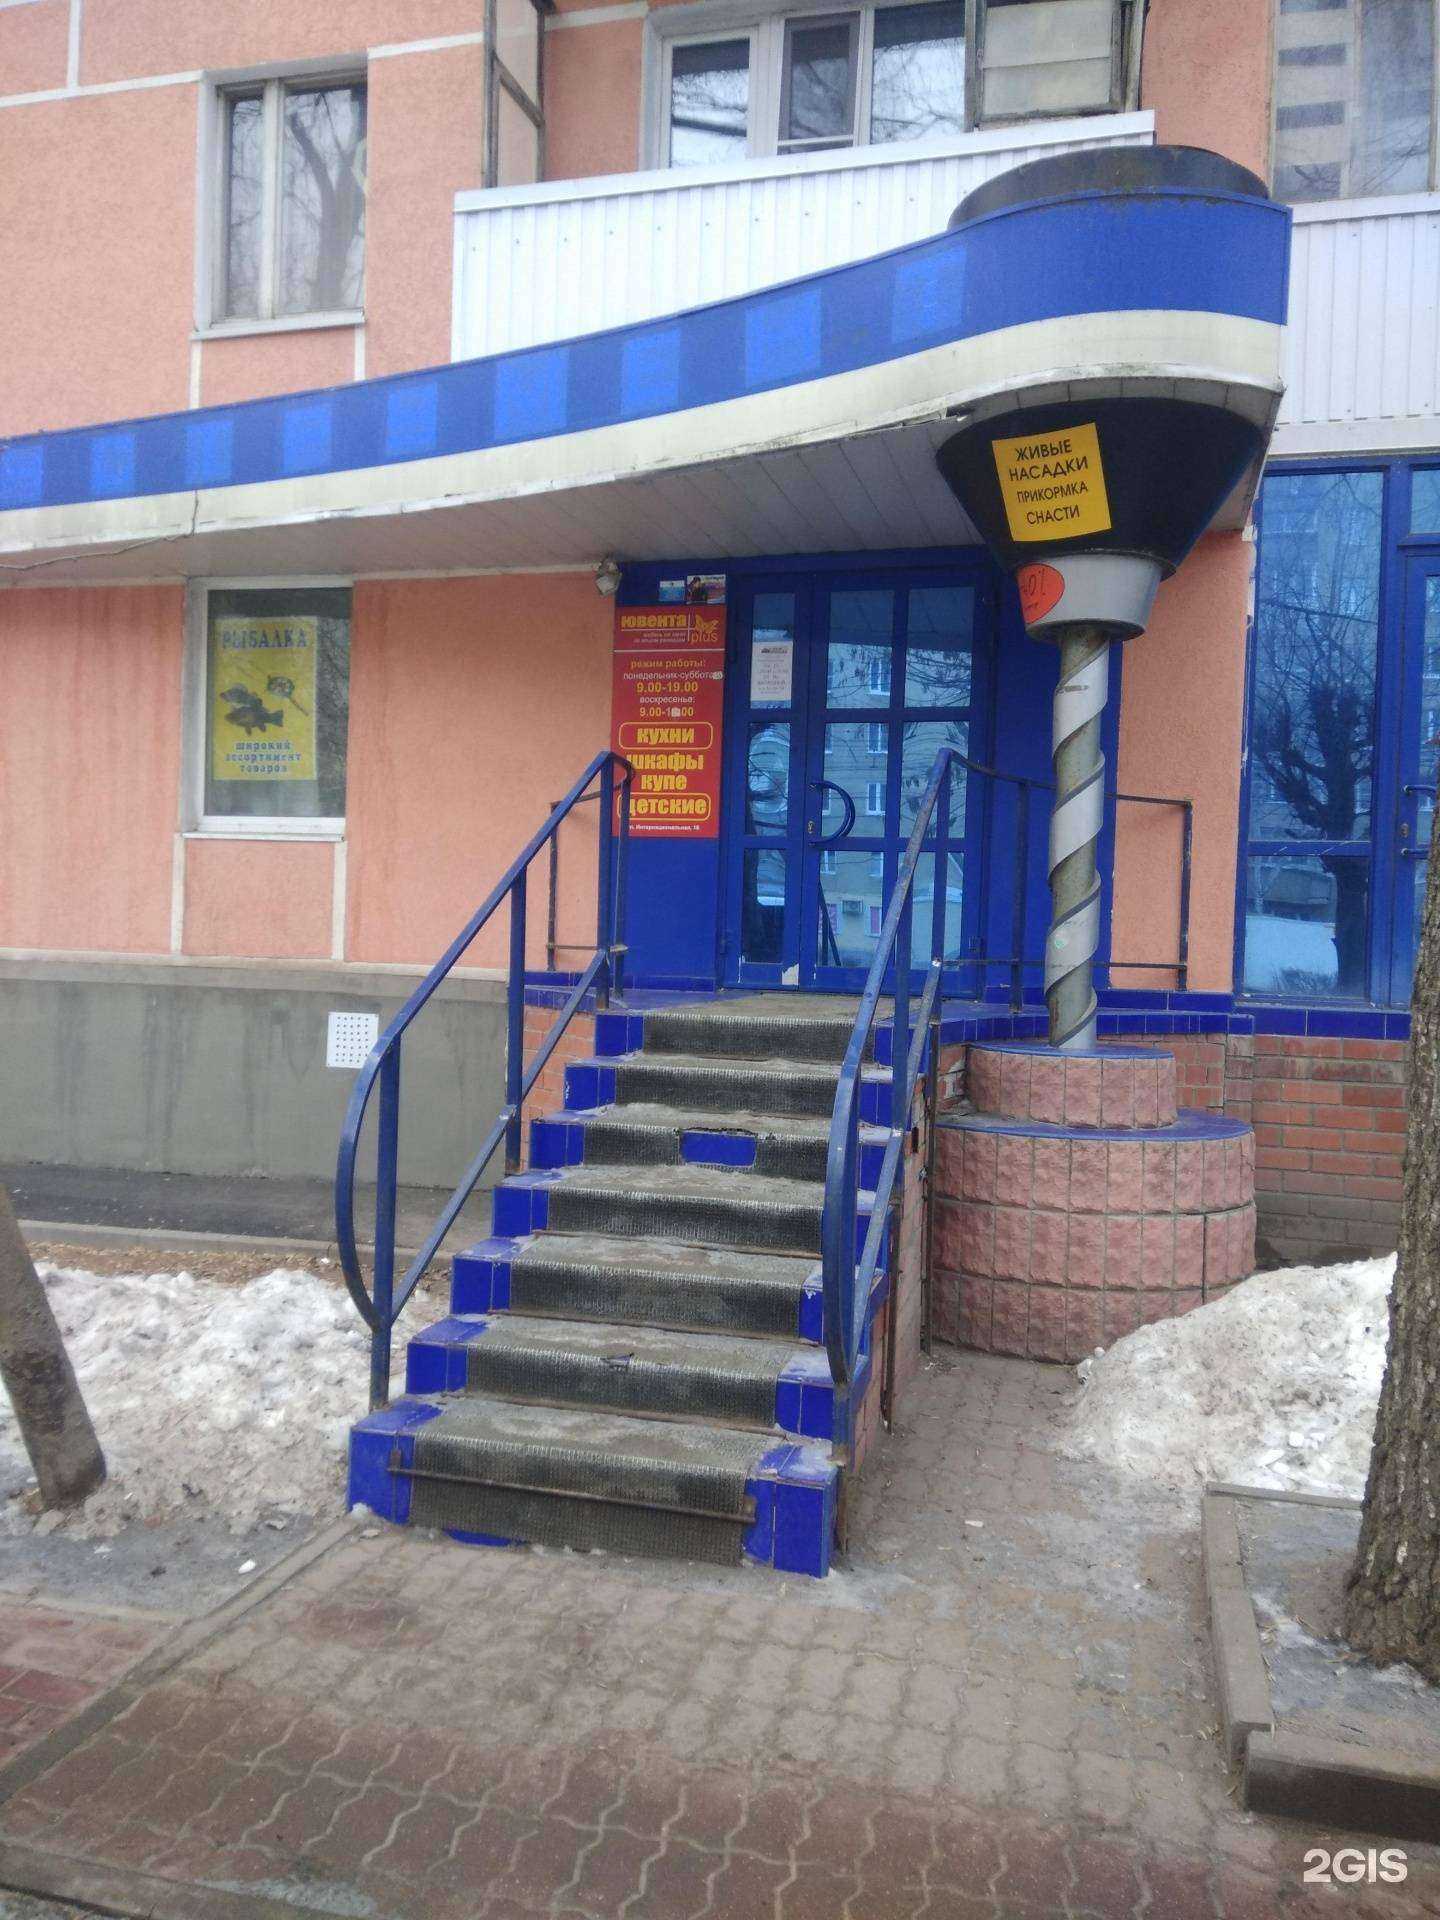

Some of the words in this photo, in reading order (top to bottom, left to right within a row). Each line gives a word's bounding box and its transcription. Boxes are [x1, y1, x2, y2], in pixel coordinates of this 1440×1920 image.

[1016, 439, 1073, 461] ЖИВЫЕ
[1009, 456, 1089, 481] НАСАДКИ
[1016, 481, 1089, 503] ПРИКОРМКА
[1026, 505, 1080, 525] СНАСТИ
[223, 628, 307, 649] РЫБАЛКА
[691, 630, 718, 643] plus
[641, 775, 687, 791] купе
